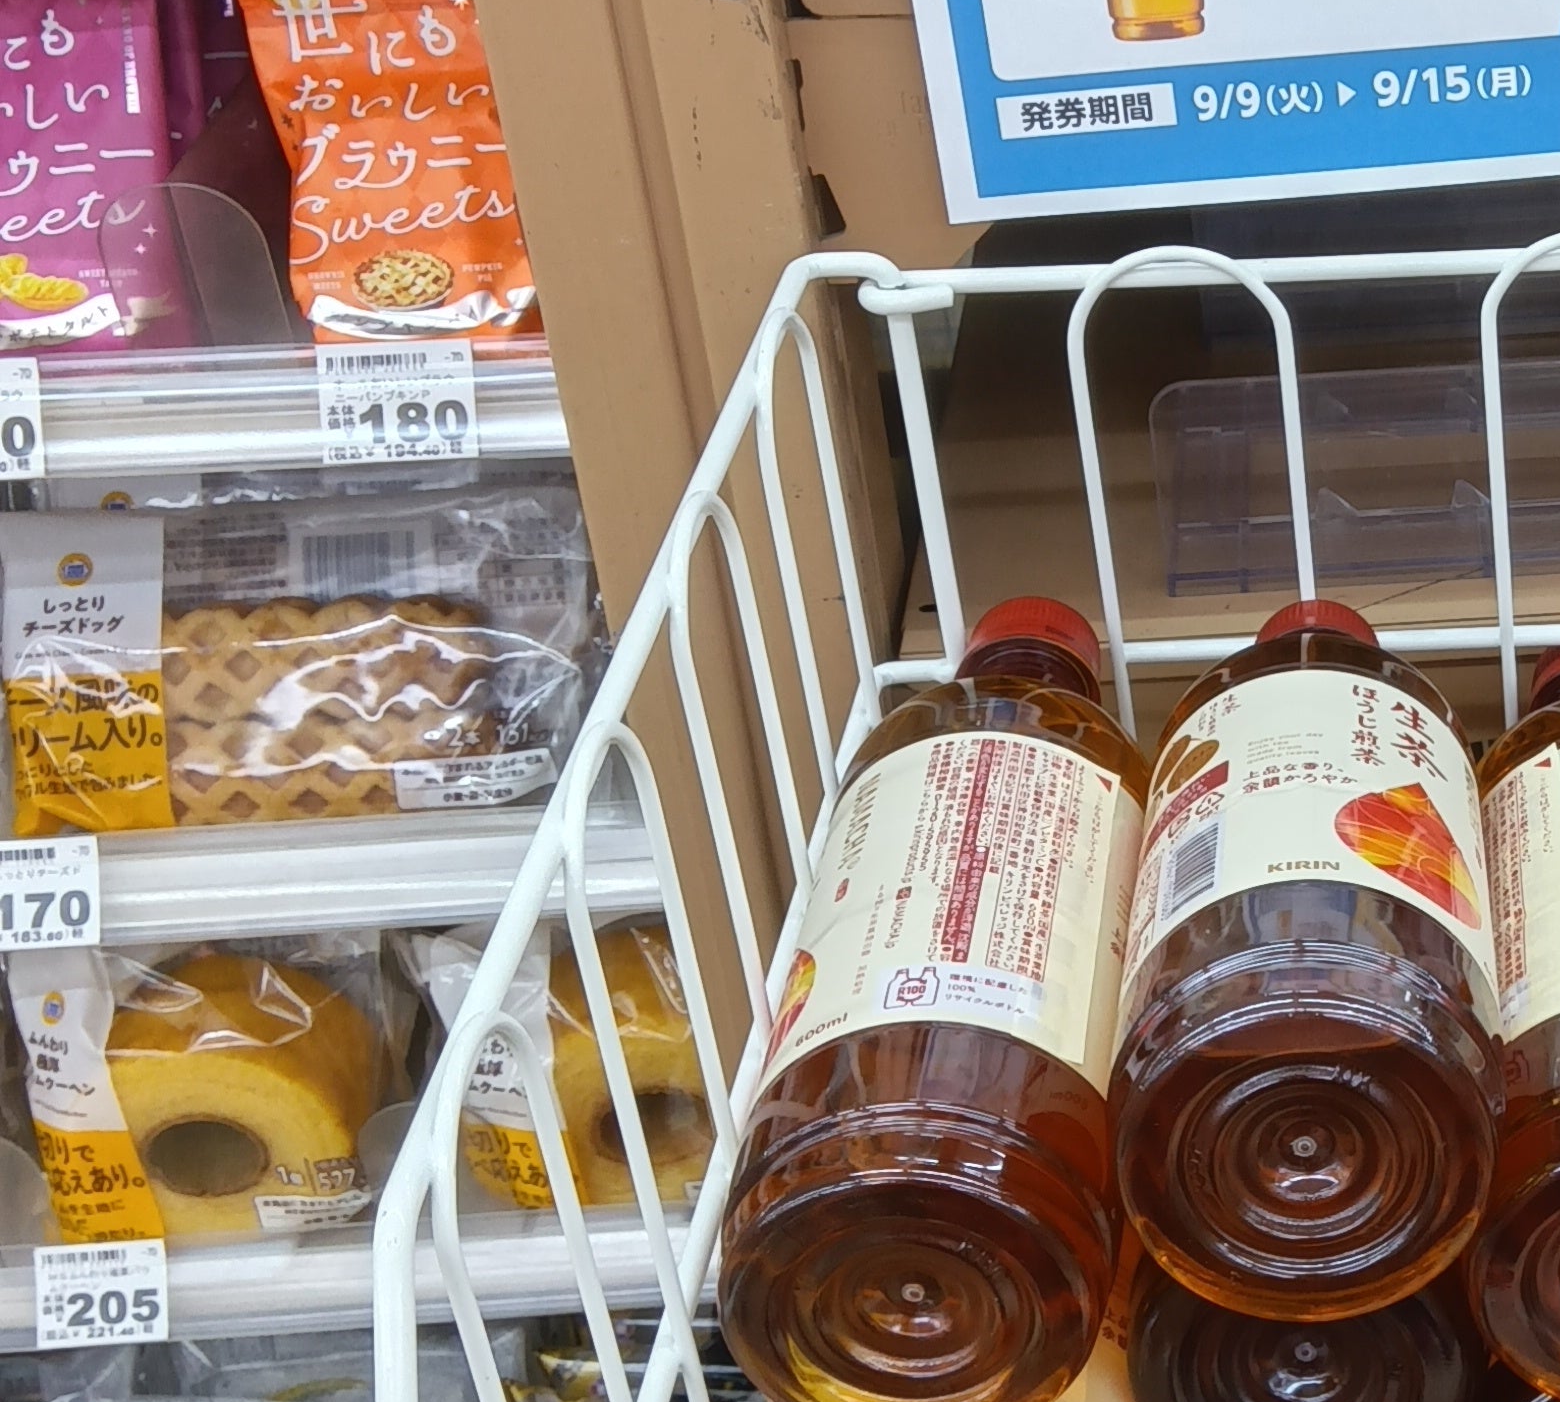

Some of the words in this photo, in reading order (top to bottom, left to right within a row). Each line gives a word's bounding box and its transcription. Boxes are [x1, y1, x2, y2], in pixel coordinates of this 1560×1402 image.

[288, 74, 491, 123] おいしい
[1019, 92, 1154, 130] 発券期間
[1193, 83, 1324, 122] 9/9(火)
[1372, 64, 1532, 108] 9/15(月)
[296, 125, 506, 190] ブラウニー
[288, 185, 518, 266] Sweets
[359, 400, 468, 443] 180
[43, 596, 105, 613] しっとり
[23, 616, 125, 637] チーズドッグ
[1350, 684, 1386, 766] ほうじ煎茶
[1390, 701, 1448, 783] 生茶
[1242, 762, 1344, 782] 上品な香り、
[1242, 774, 1359, 795] 余韻かろやか
[1266, 859, 1341, 874] KIRIN
[795, 1012, 848, 1048] 600ml
[67, 1290, 160, 1326] 205
